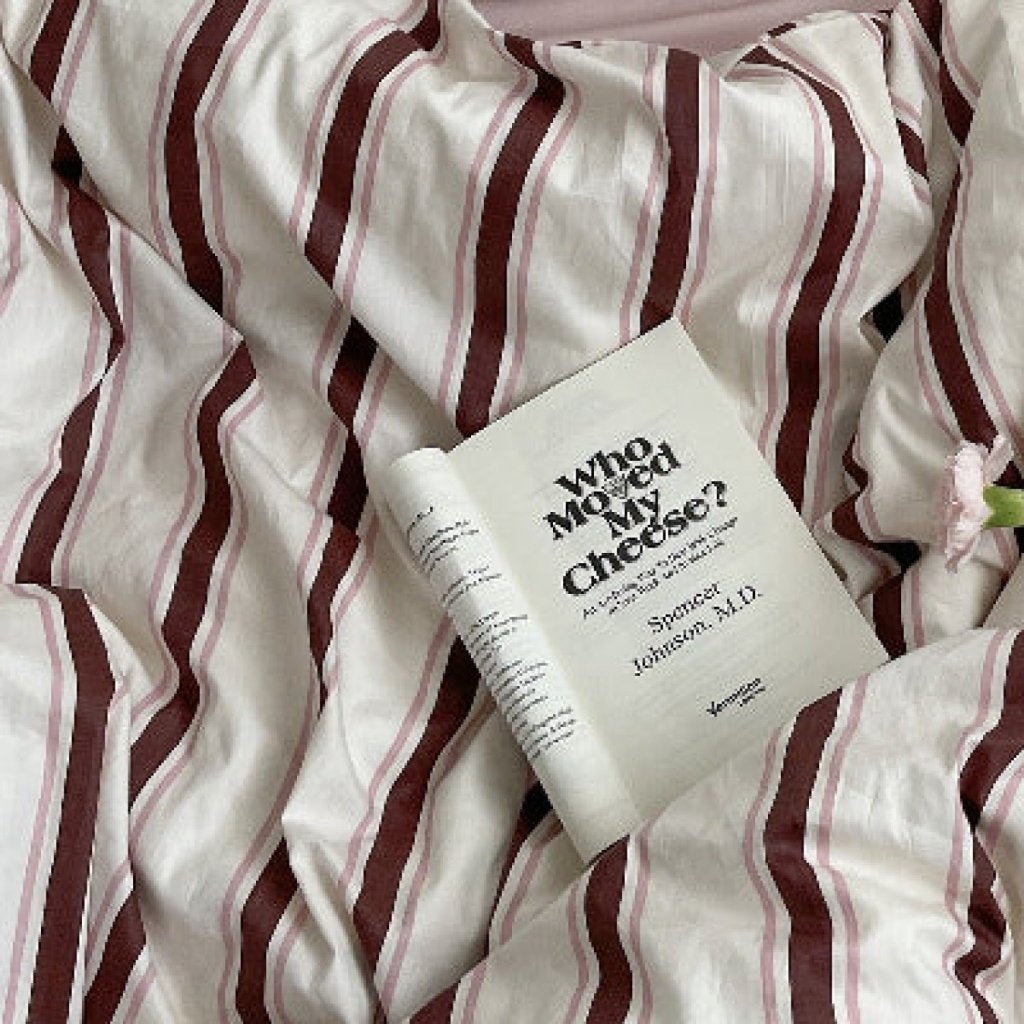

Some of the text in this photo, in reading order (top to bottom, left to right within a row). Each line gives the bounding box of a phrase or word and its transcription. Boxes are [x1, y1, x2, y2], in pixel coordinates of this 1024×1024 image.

[543, 441, 682, 540] Moved
[554, 437, 652, 496] Who
[562, 481, 727, 596] Cheese?
[602, 489, 660, 539] My
[648, 583, 720, 634] Spencer
[713, 585, 763, 622] M.D.
